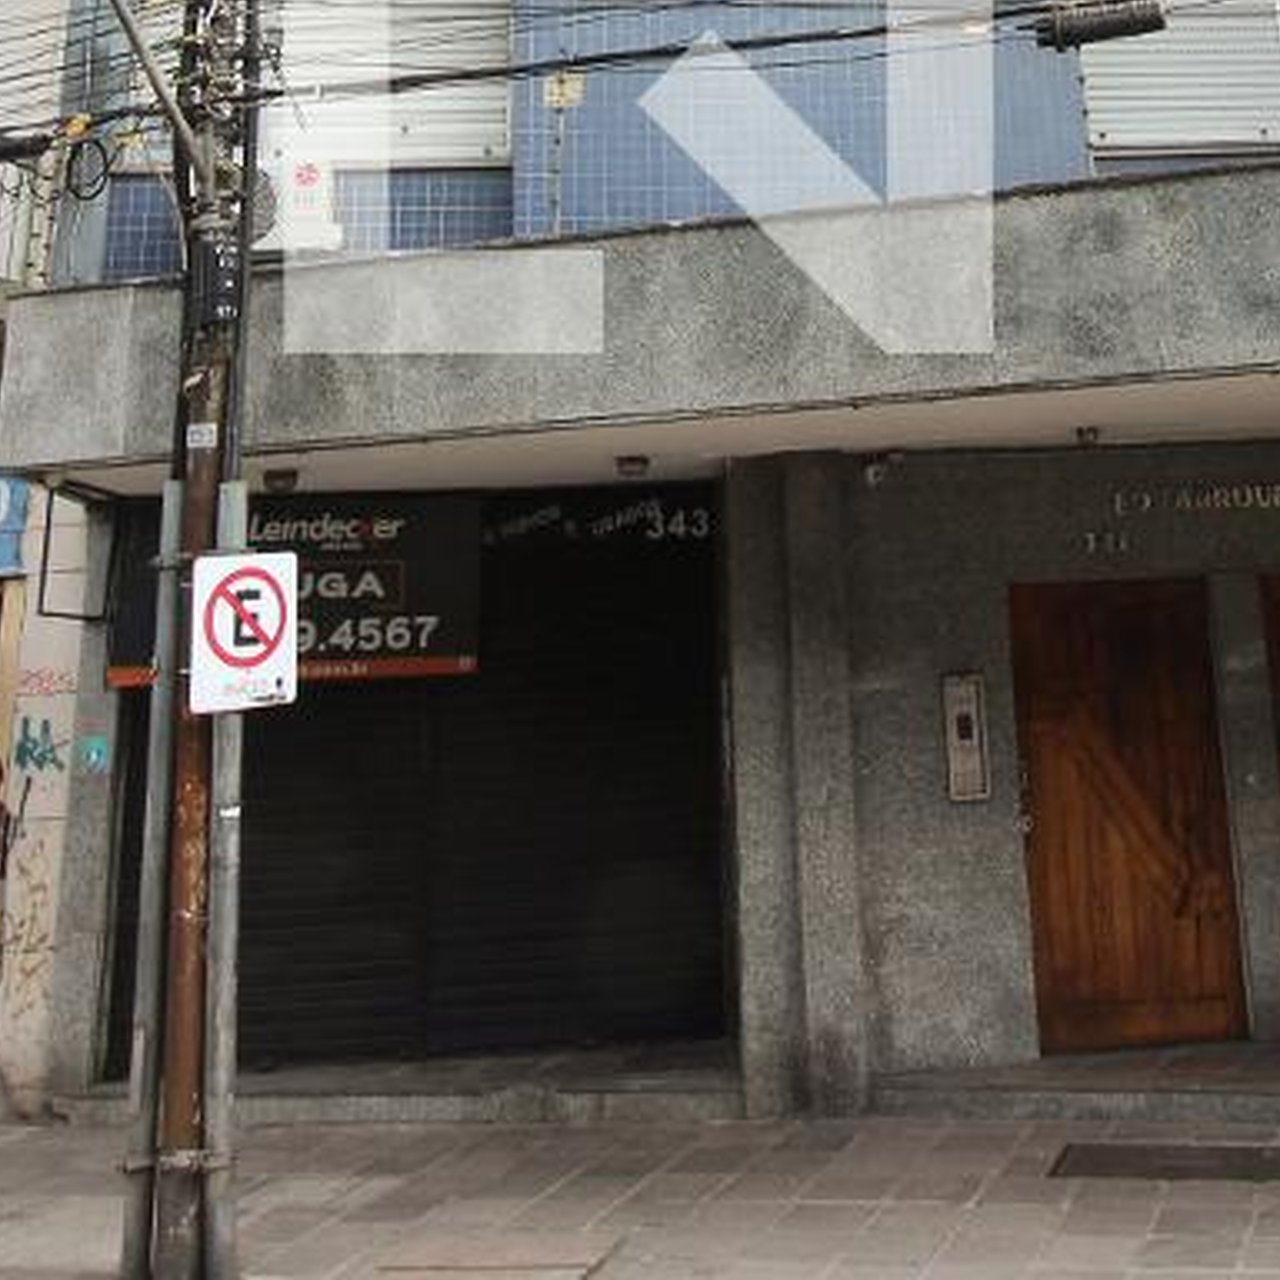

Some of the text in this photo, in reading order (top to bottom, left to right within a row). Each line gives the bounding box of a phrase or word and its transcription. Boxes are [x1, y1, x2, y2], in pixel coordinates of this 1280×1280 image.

[645, 508, 709, 539] 343
[297, 570, 385, 599] UGA
[297, 615, 440, 652] 9.4567
